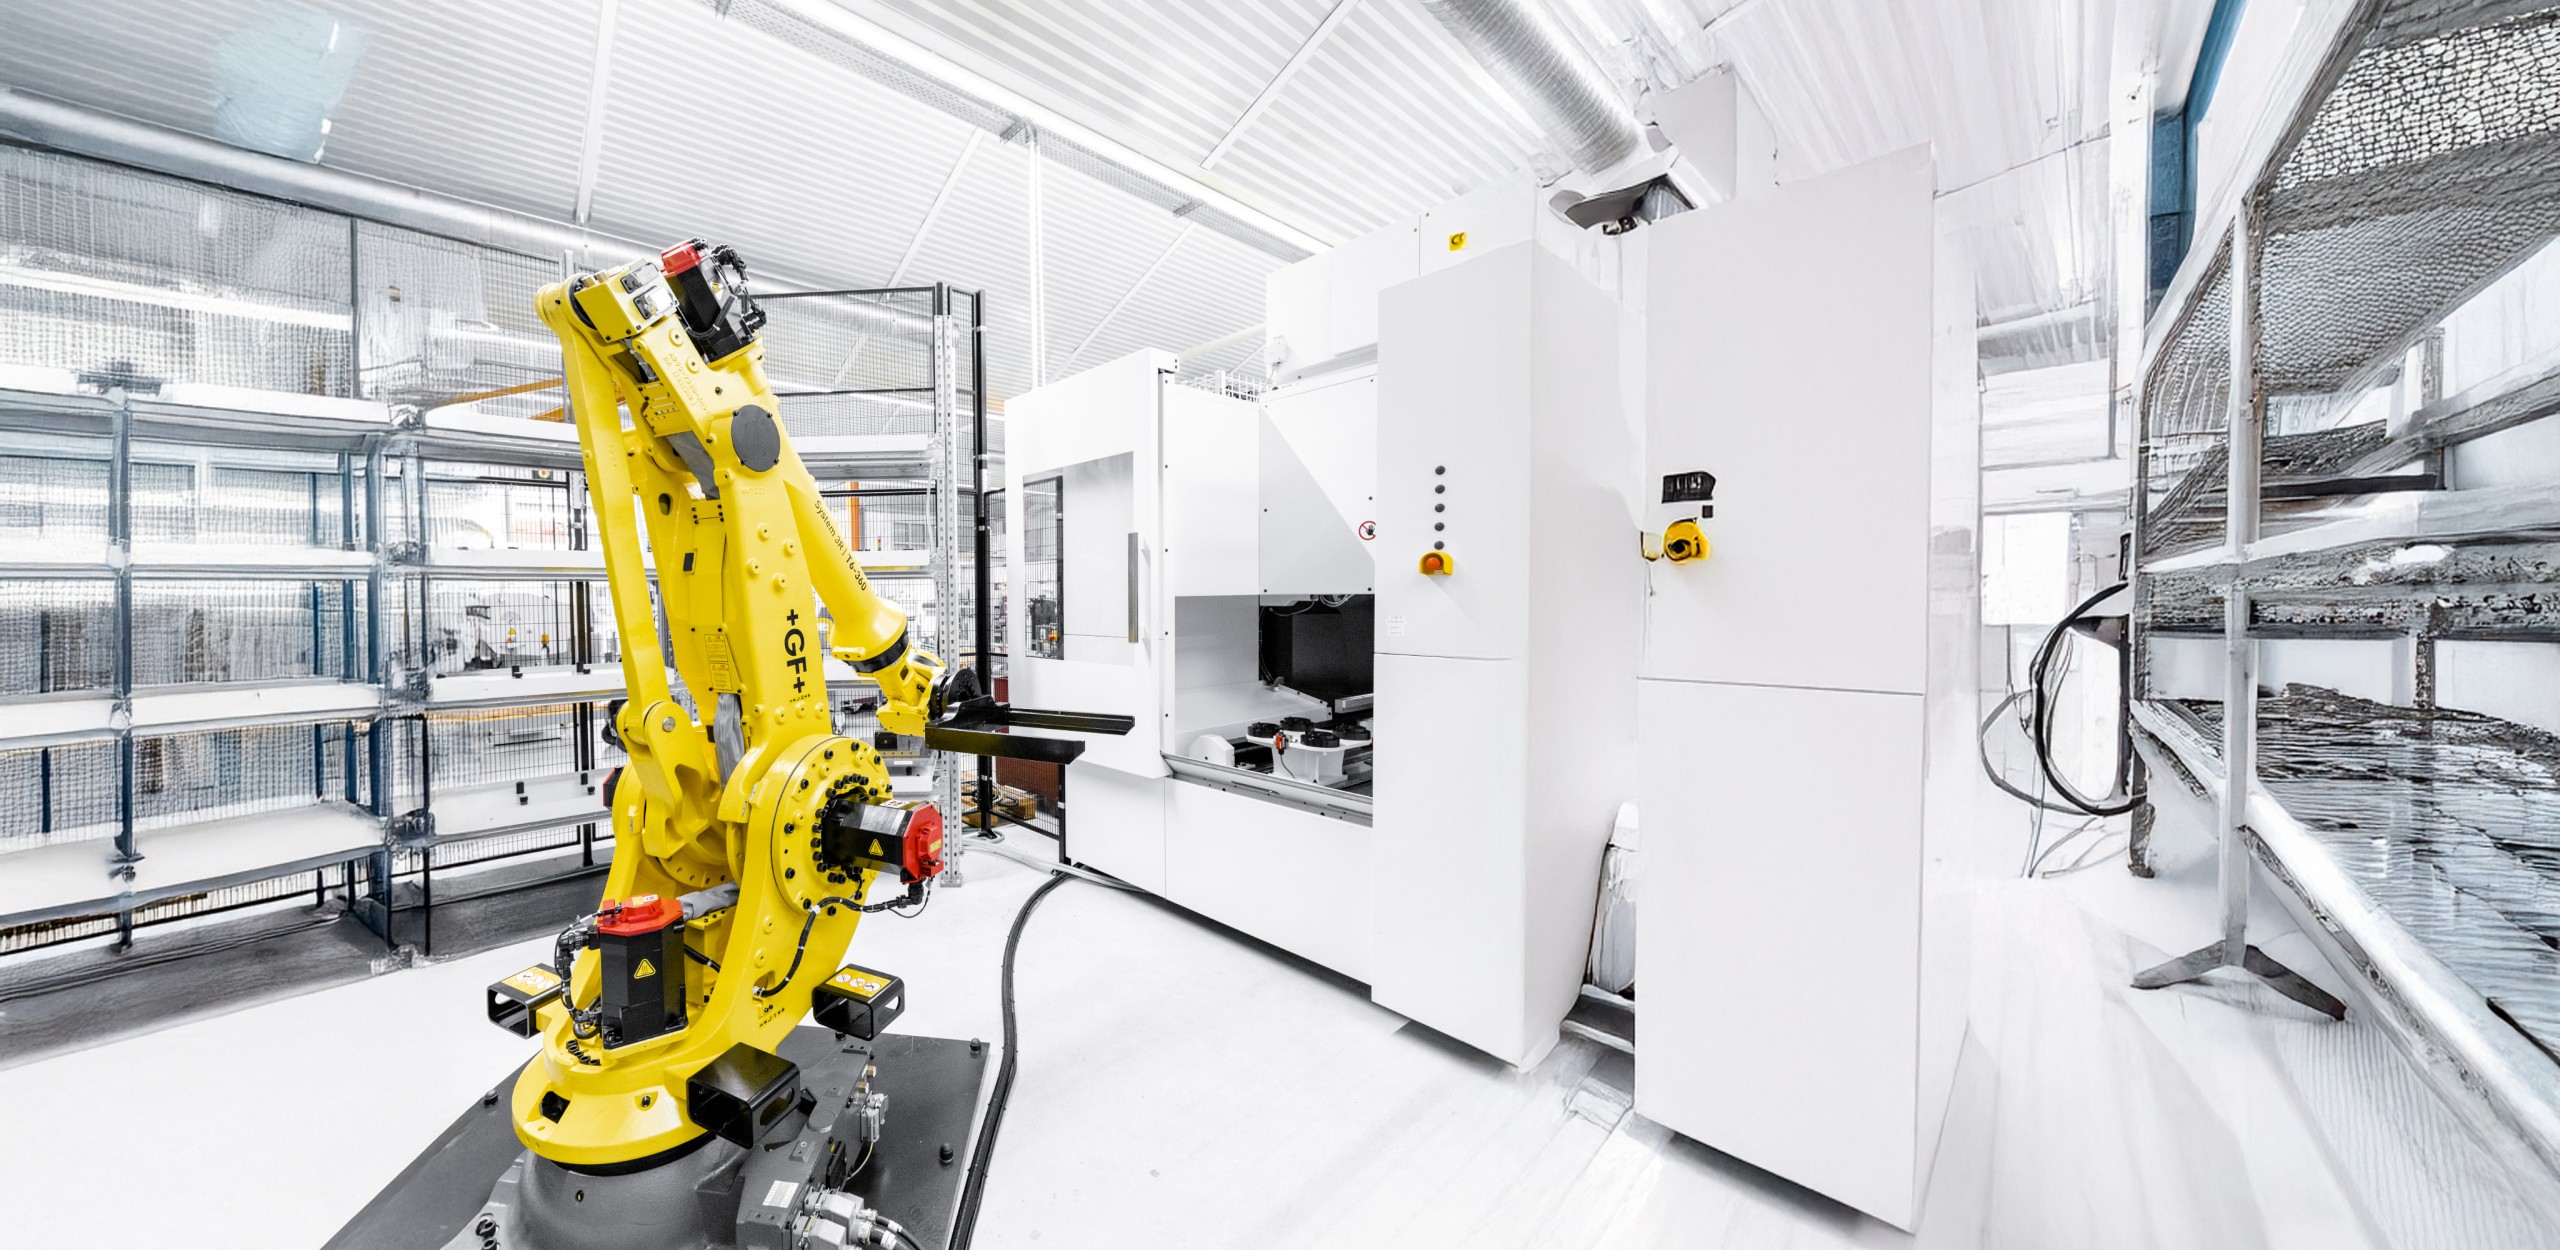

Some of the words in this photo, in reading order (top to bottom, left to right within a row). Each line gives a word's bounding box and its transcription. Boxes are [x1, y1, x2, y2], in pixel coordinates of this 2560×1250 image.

[814, 500, 836, 537] System
[834, 535, 844, 551] 3R
[845, 553, 867, 591] T6-360
